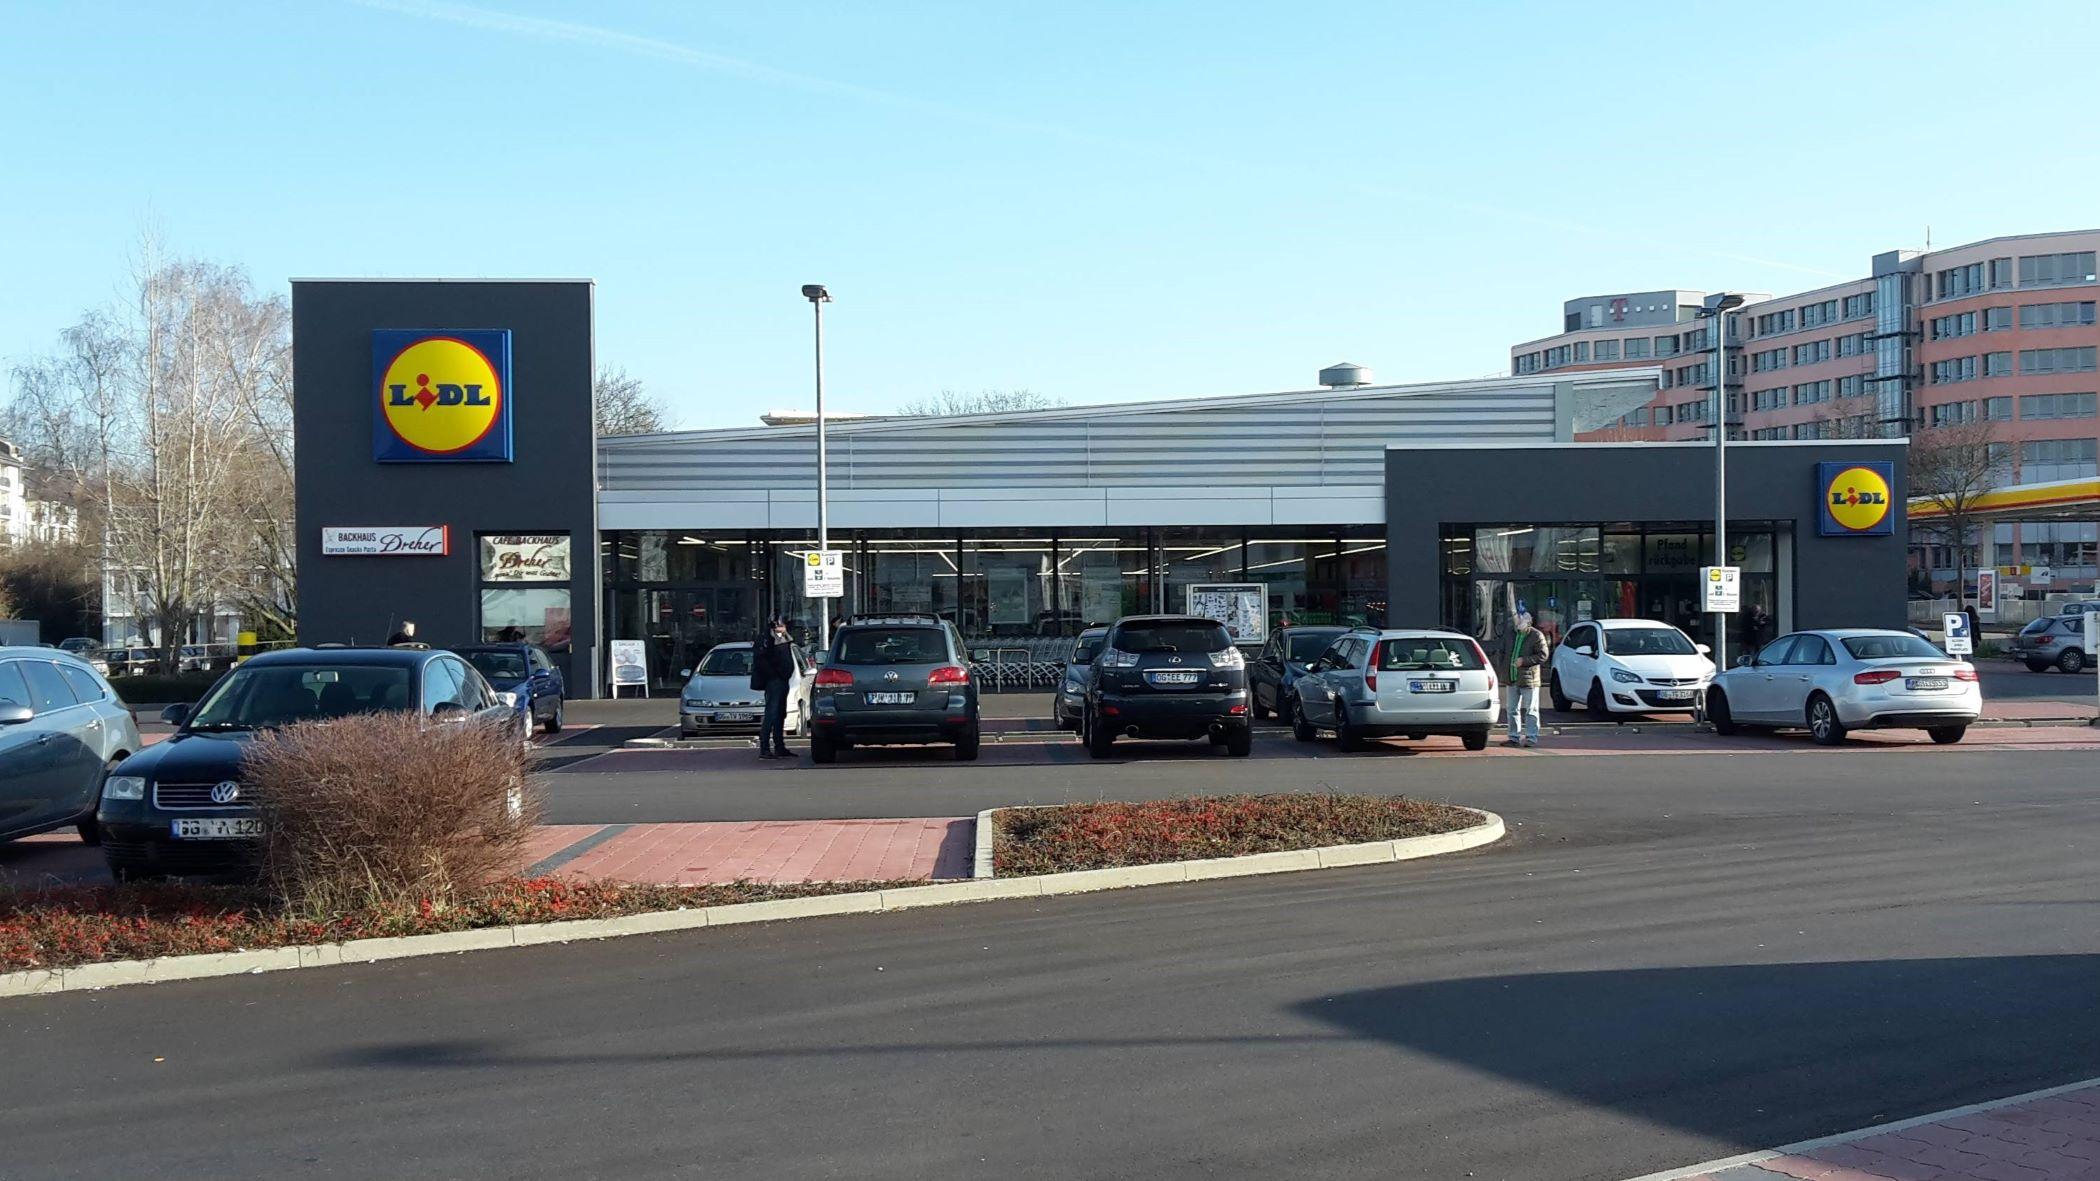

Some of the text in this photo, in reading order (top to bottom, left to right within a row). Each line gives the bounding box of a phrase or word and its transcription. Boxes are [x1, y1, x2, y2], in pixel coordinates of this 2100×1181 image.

[338, 527, 441, 552] BACKHAUS Dreher
[515, 536, 560, 545] BACKHAUS
[1657, 538, 1687, 551] Pfand
[499, 545, 552, 569] Dreher
[1945, 614, 1963, 637] P
[1183, 673, 1197, 681] 777
